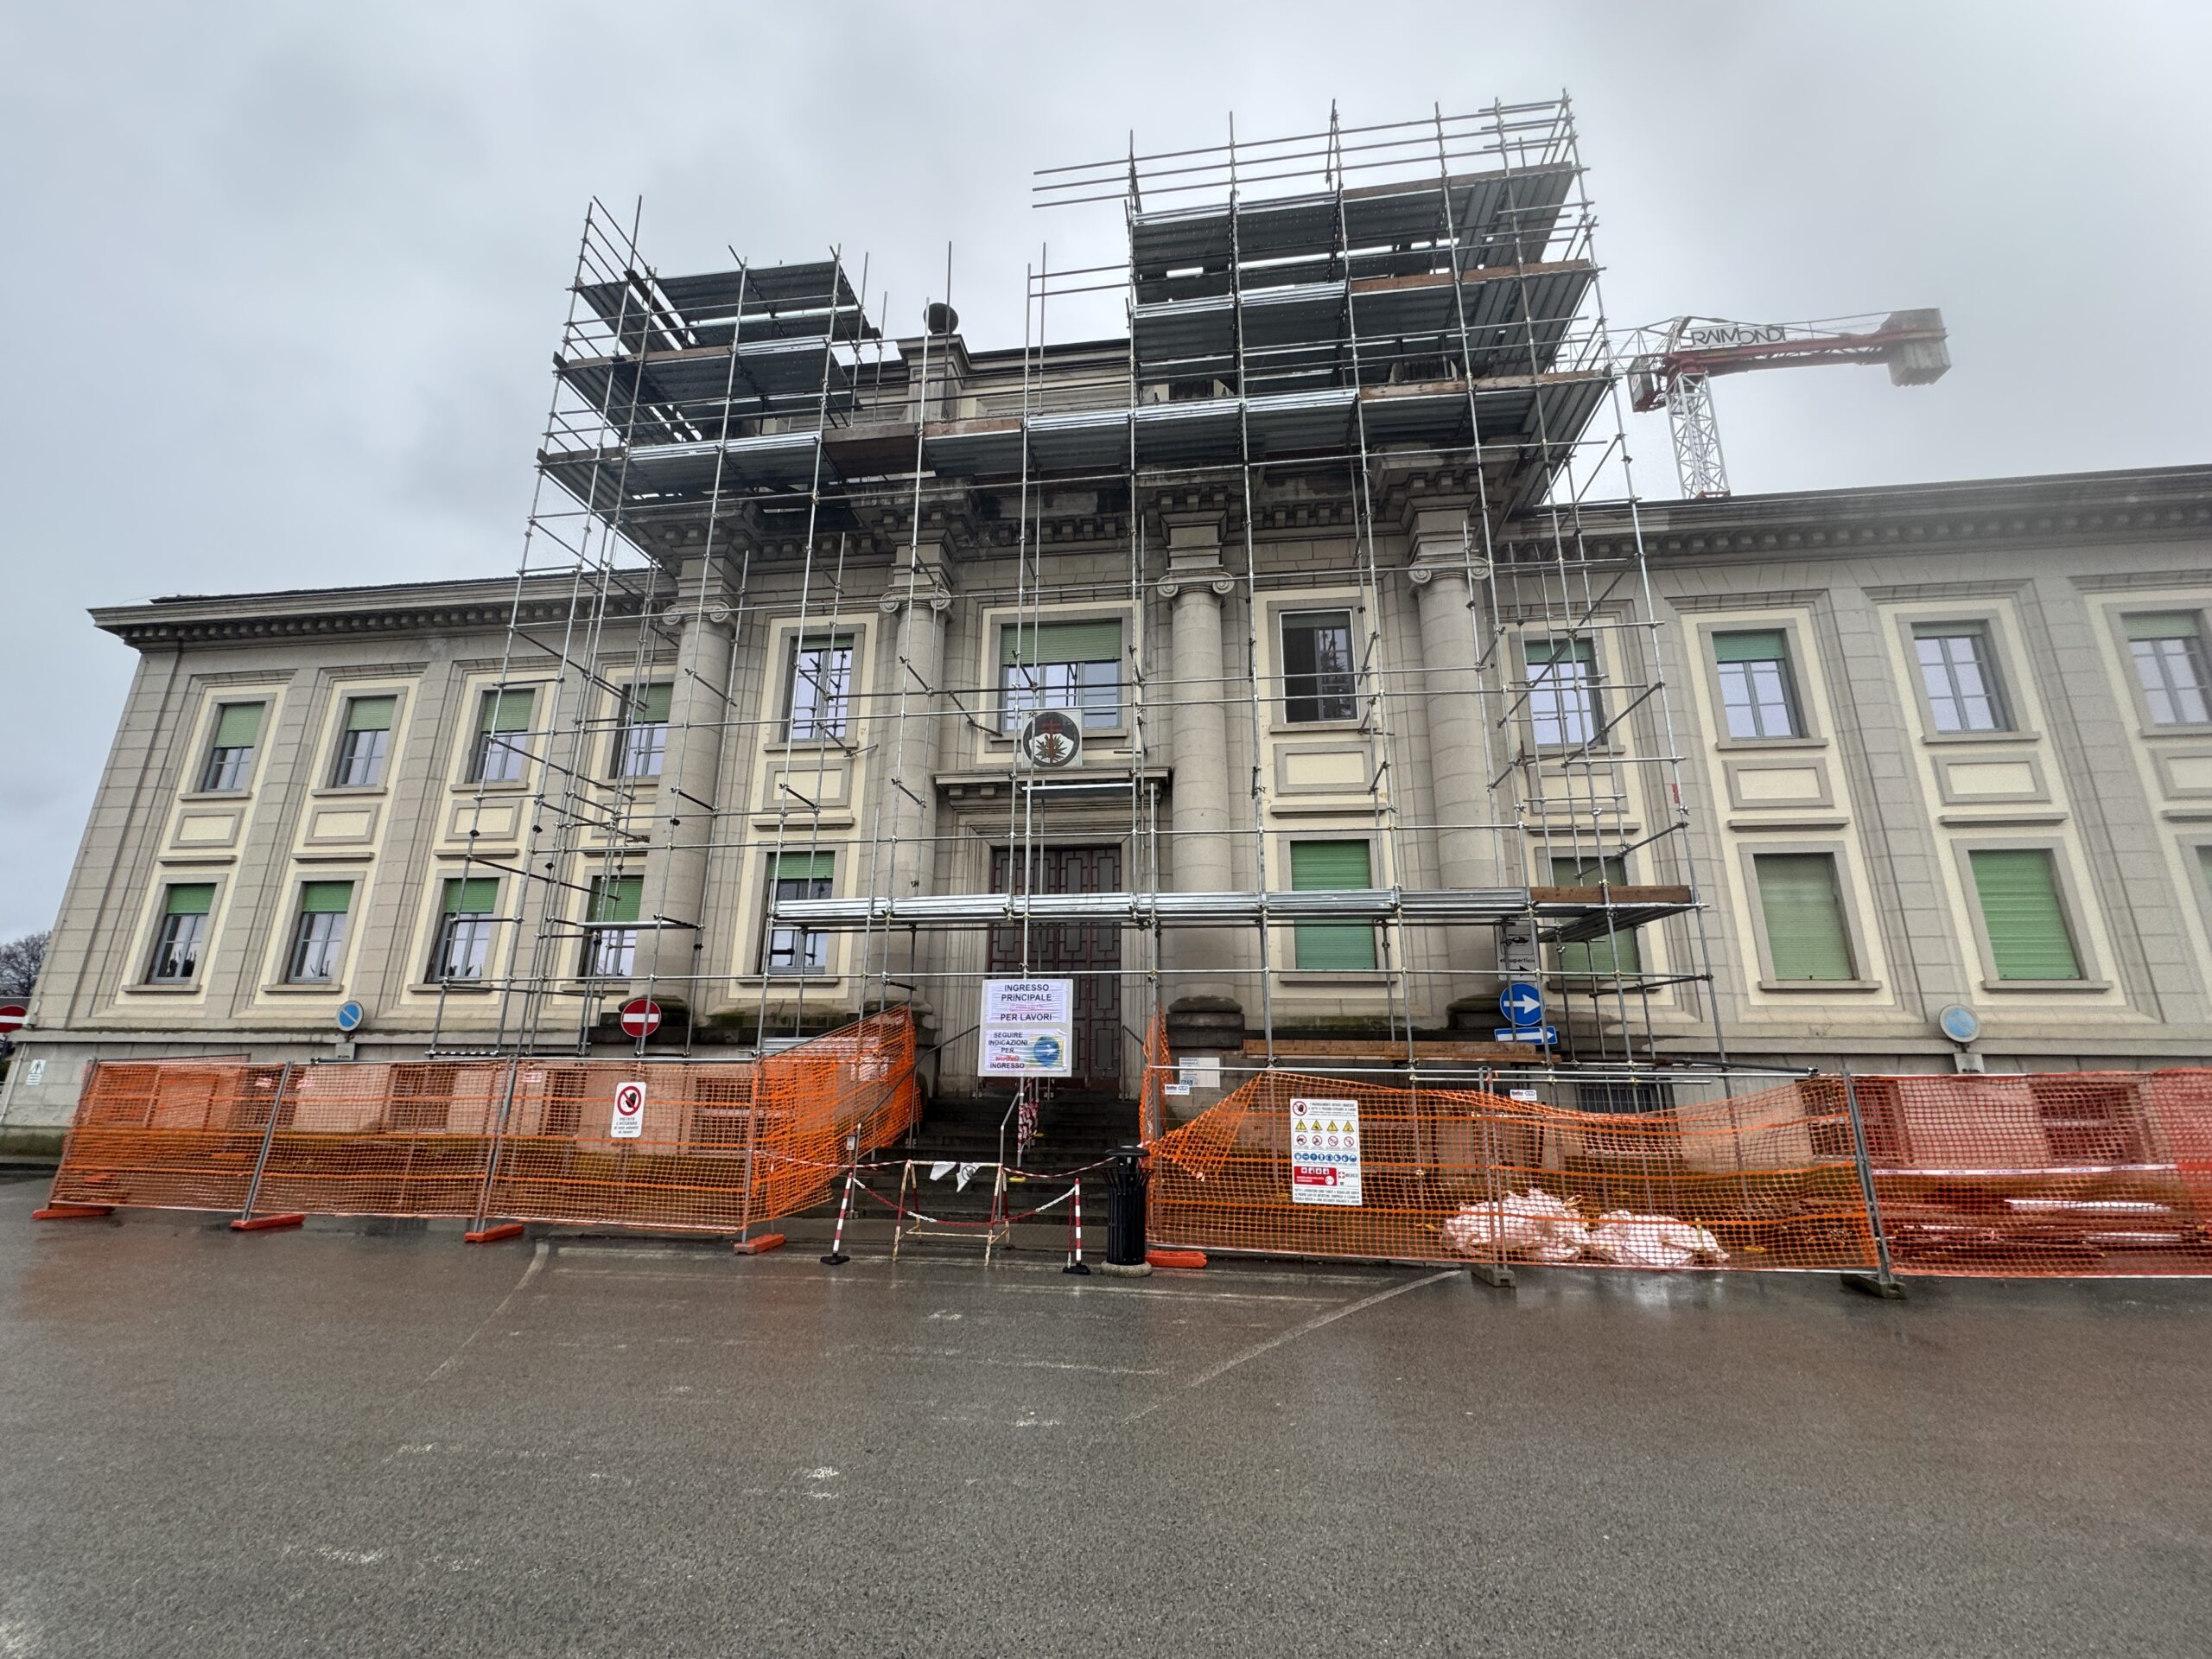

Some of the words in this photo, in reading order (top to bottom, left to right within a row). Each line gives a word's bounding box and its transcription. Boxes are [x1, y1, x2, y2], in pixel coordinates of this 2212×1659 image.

[1692, 327, 1786, 345] RAIMONDI
[1004, 983, 1049, 992] INGRESSO
[1020, 1013, 1052, 1021] LAVORI
